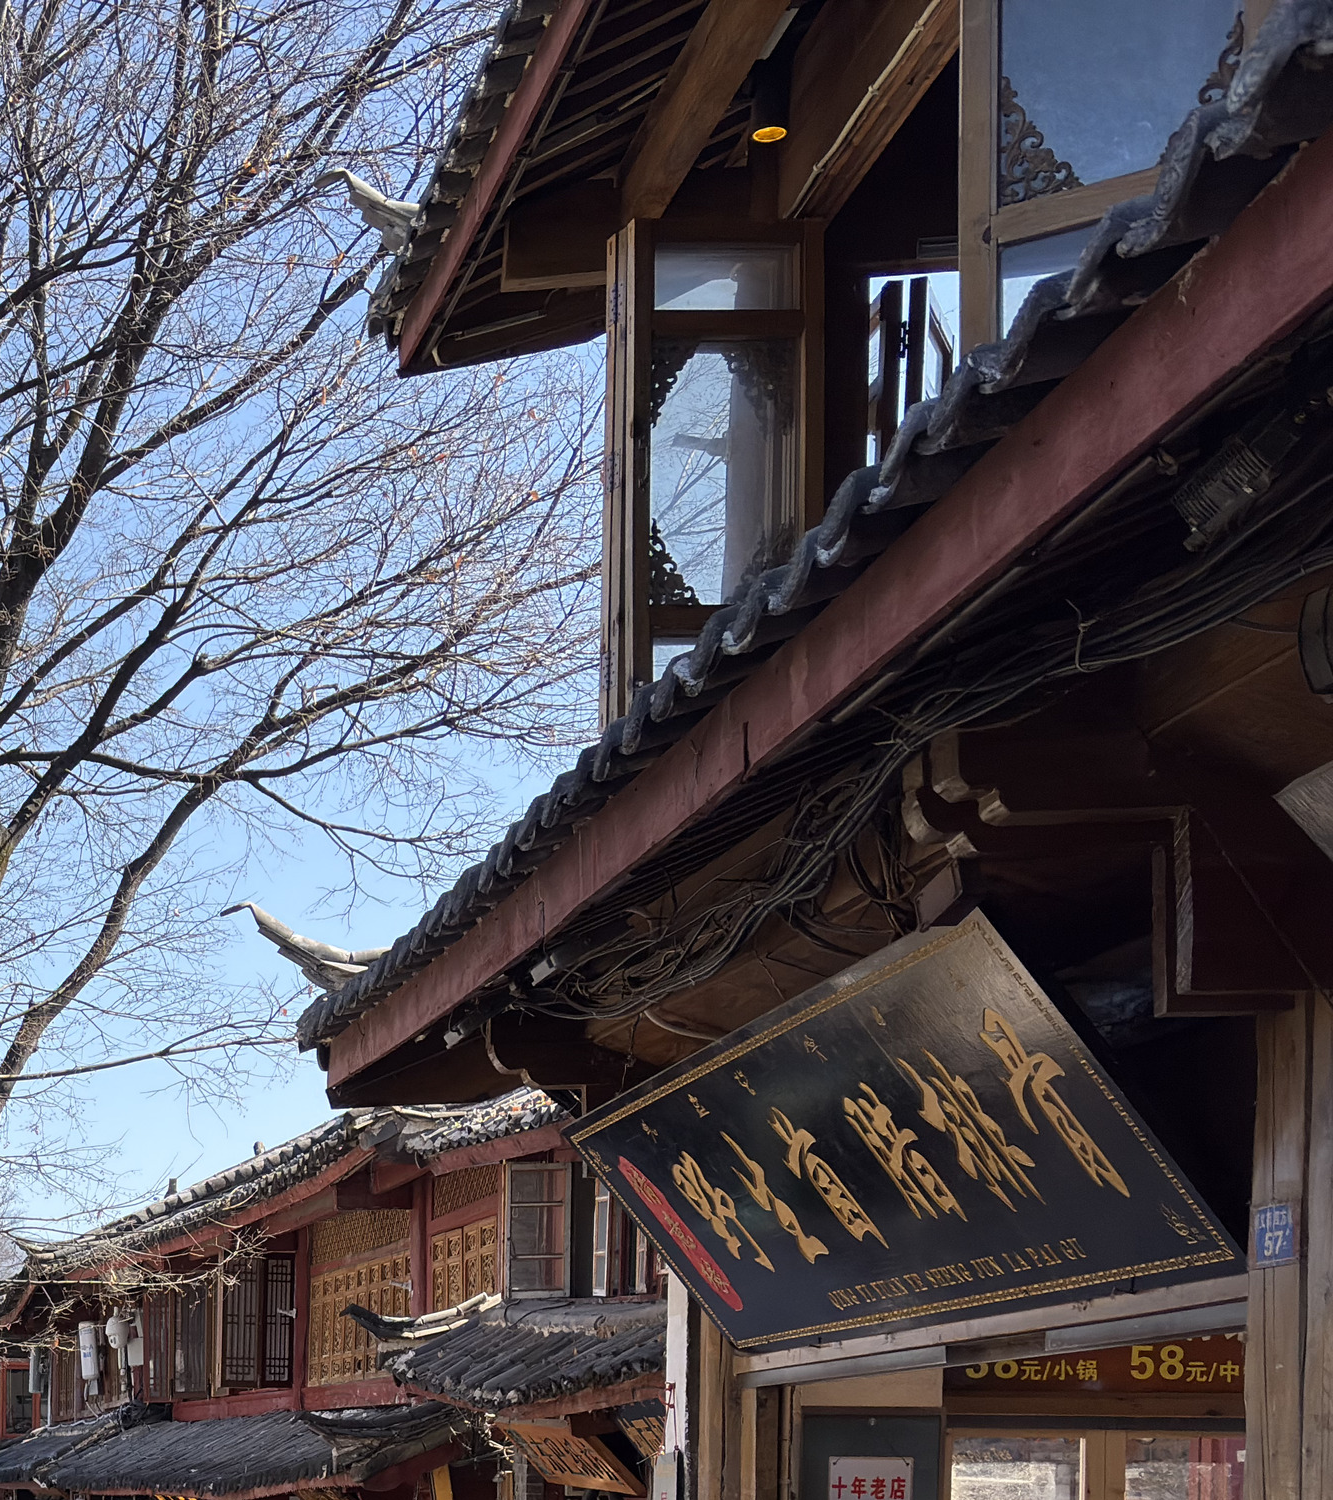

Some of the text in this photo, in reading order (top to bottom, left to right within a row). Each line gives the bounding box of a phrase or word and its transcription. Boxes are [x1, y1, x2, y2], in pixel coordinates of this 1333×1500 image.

[924, 1263, 973, 1288] SHENG
[970, 1256, 1004, 1279] JUN
[1002, 1250, 1031, 1272] LA
[1025, 1243, 1061, 1267] PAI
[1059, 1237, 1087, 1260] GU
[1131, 1345, 1244, 1383] 58元/中
[832, 1476, 906, 1500] 十年老店
